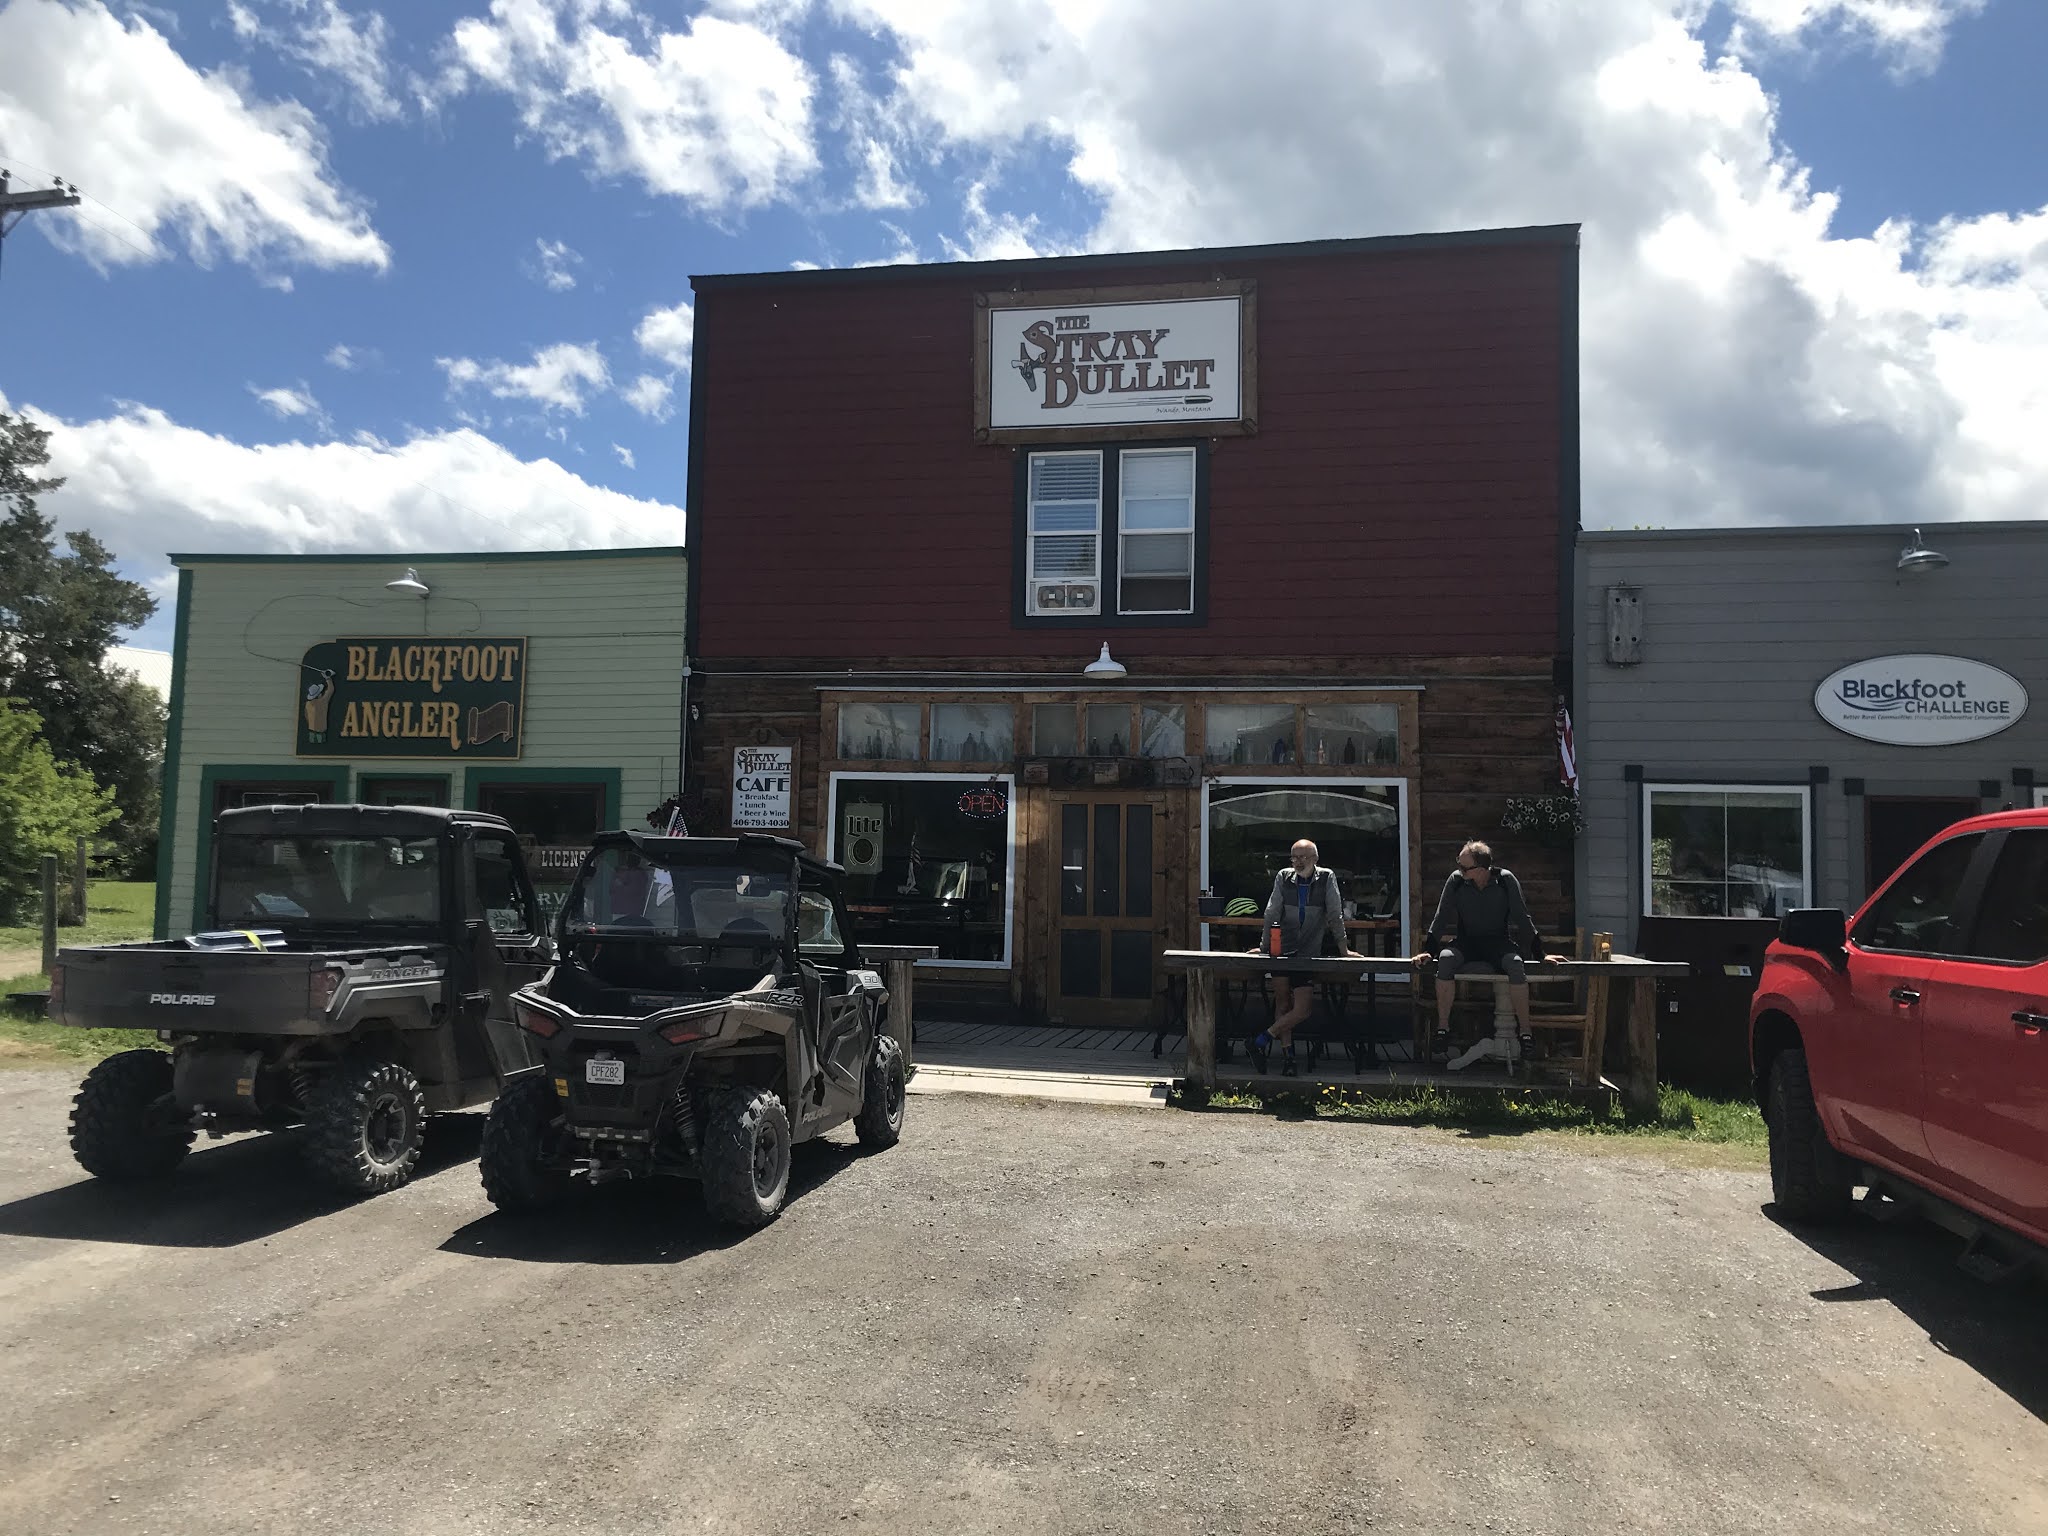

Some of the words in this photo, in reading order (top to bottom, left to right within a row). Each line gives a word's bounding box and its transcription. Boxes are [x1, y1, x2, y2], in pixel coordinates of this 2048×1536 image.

[1055, 315, 1090, 331] THE
[1022, 320, 1170, 364] STRAY
[1040, 359, 1215, 410] BULLET
[346, 645, 519, 694] BLACKFOOT
[1842, 679, 1967, 699] Blackfoot
[1904, 701, 2010, 713] CHALLENGE
[340, 700, 462, 750] ANGLER
[738, 749, 780, 763] STRAY
[743, 762, 791, 774] BULLET
[735, 777, 790, 792] CAFE
[959, 795, 1005, 812] OPEN
[733, 819, 790, 827] 406-793-4030
[846, 814, 882, 837] Lite
[541, 850, 594, 867] LICENS
[370, 966, 432, 980] RANGER
[150, 993, 216, 1006] POLARIS
[767, 991, 805, 1006] RZR
[592, 1066, 619, 1078] CPF282
